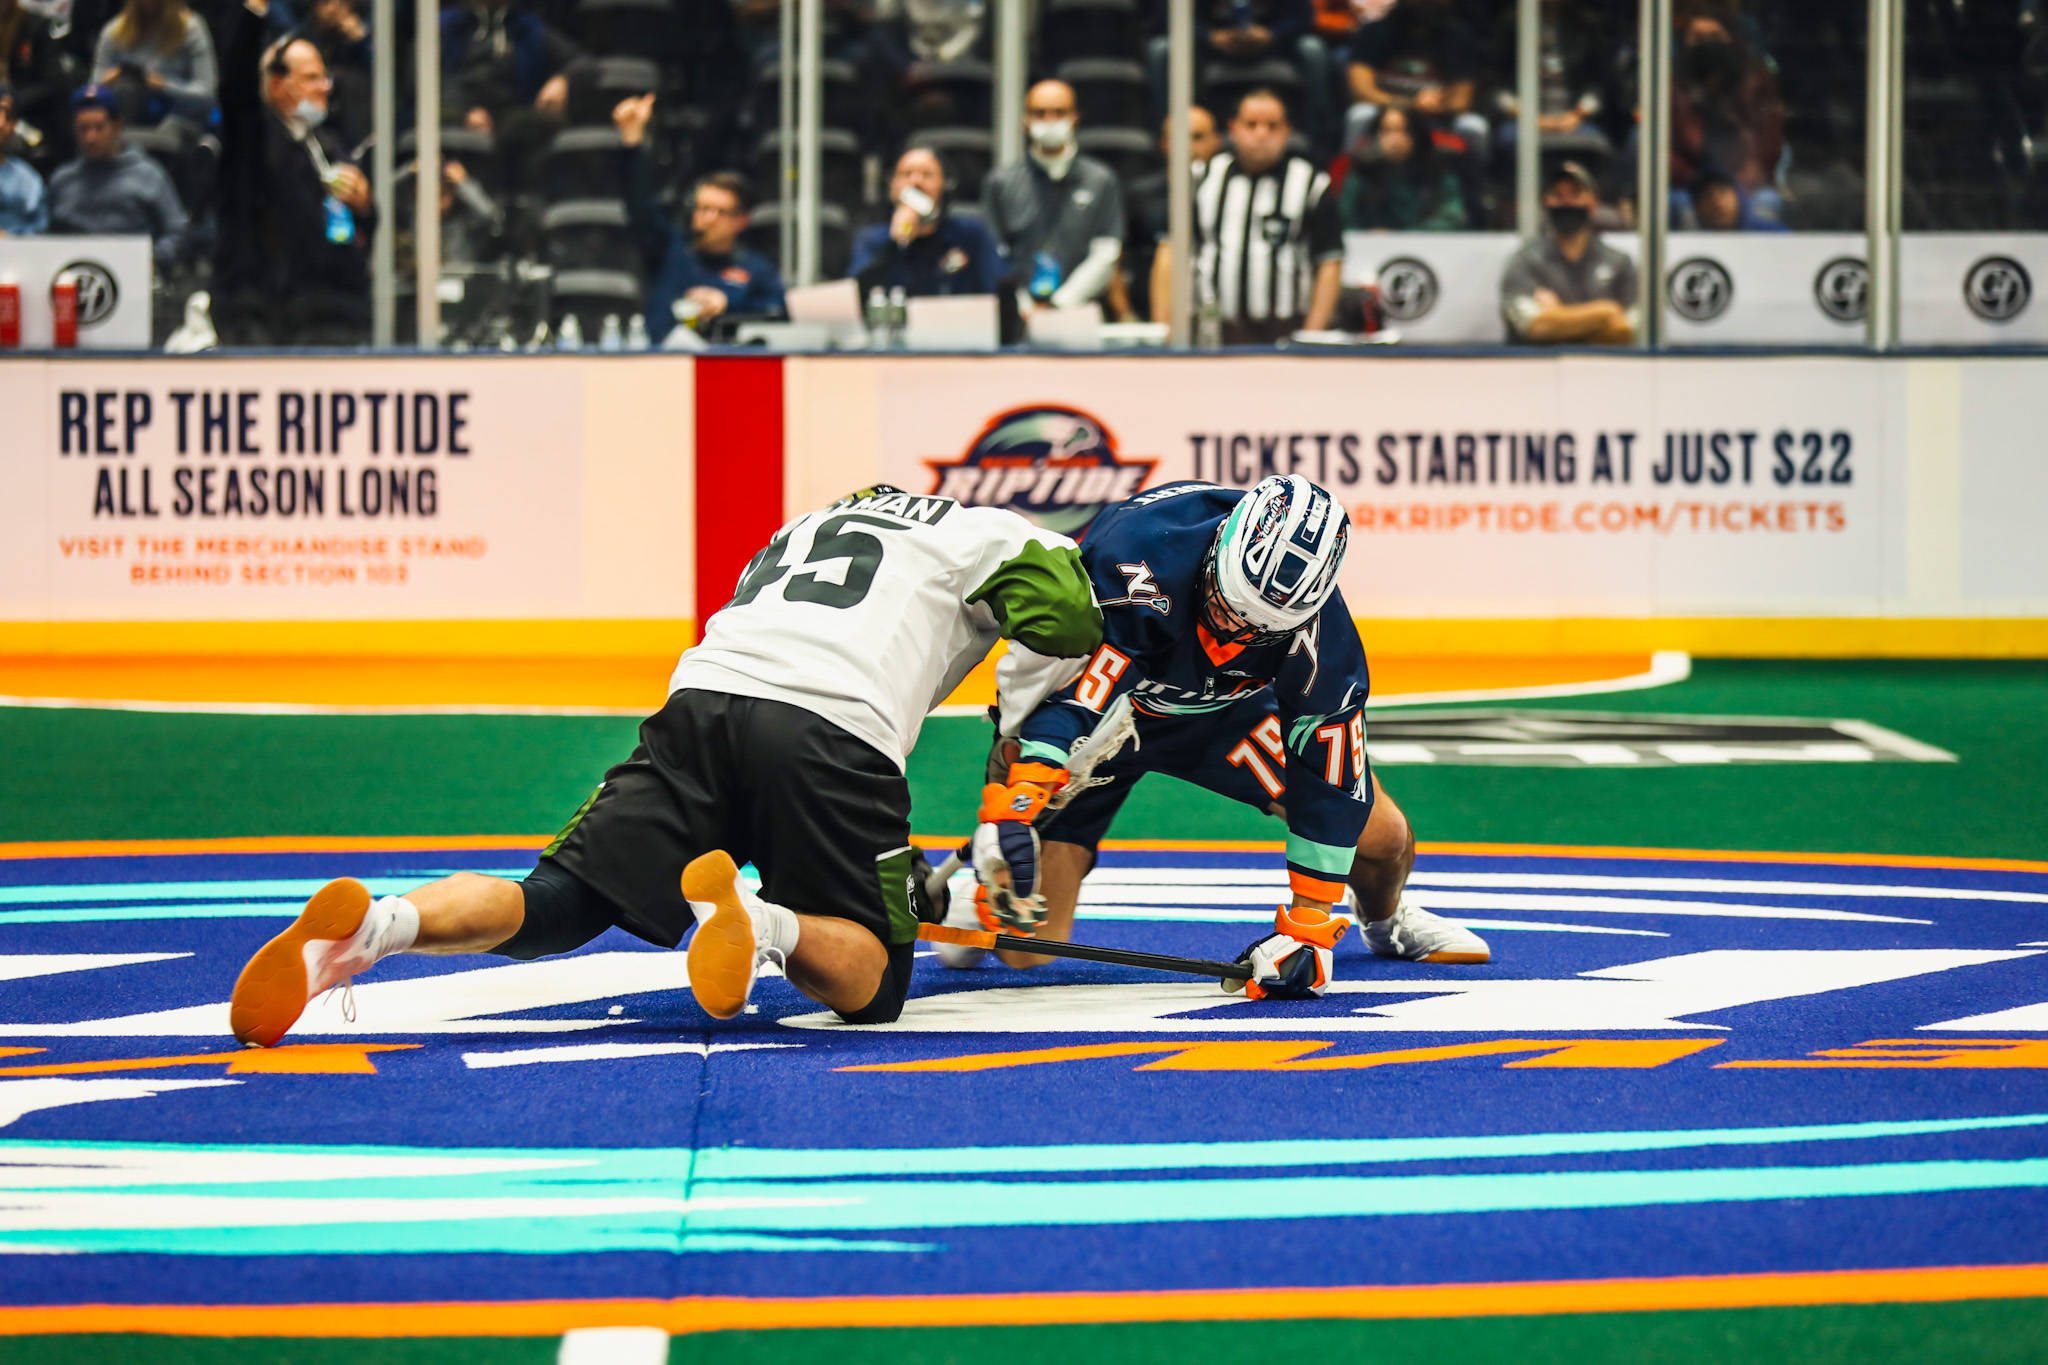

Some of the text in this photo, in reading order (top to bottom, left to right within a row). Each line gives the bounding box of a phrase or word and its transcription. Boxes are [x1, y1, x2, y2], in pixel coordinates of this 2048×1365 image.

[59, 391, 471, 456] REP THE RIPTIDE
[1189, 431, 1853, 486] TICKETS STARTING AT JUST $22
[94, 467, 439, 518] ALL SEASON LONG
[938, 465, 1145, 505] RIPTIDE
[1353, 501, 1847, 535] RKRIPTIDE.COM/TICKETS
[59, 536, 487, 558] VISIT THE MERCHANDISE STAND
[720, 513, 912, 610] 45
[130, 564, 231, 585] BEHIND
[240, 564, 356, 585] SECTION
[1317, 710, 1366, 788] 75
